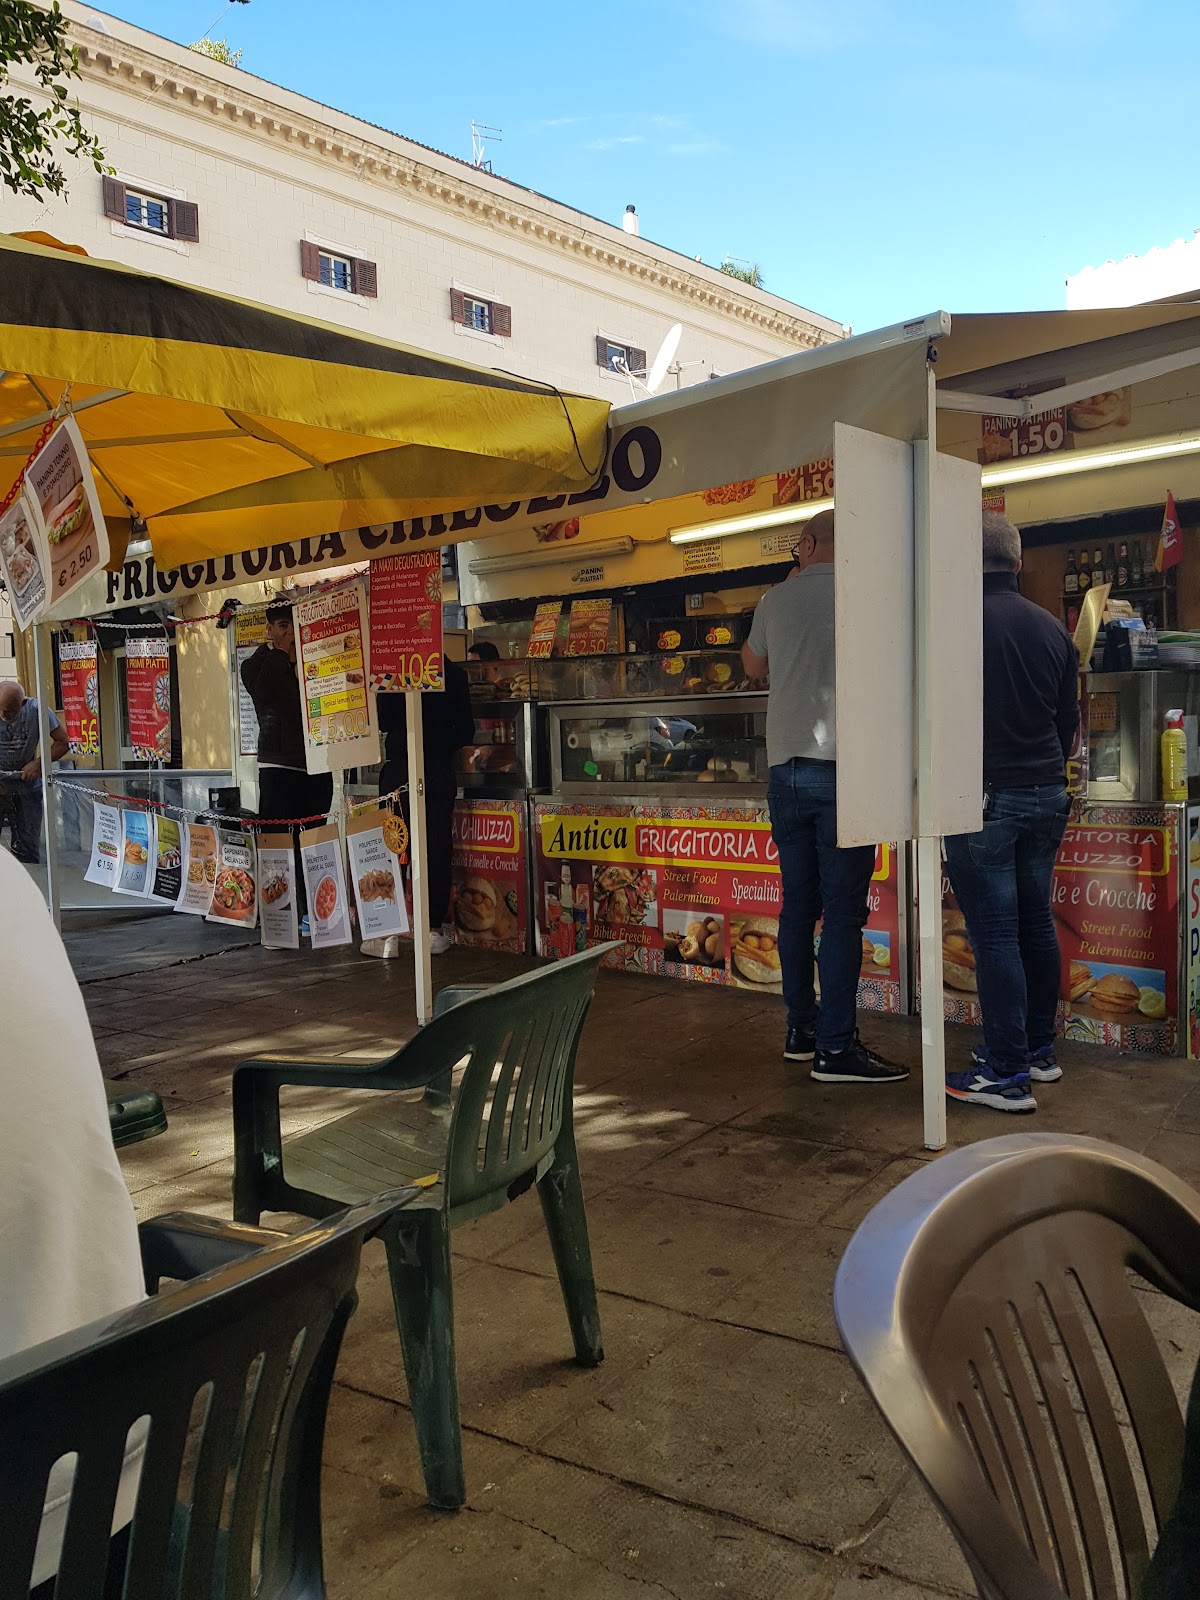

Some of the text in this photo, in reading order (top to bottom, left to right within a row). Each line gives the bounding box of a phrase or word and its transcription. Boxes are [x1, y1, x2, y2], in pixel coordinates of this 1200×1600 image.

[1010, 421, 1064, 457] 1.50
[58, 569, 67, 588] €
[580, 565, 604, 576] PANINI
[322, 615, 345, 628] TYPICAL
[334, 621, 359, 634] TASTING
[145, 658, 168, 669] PIATTI
[460, 815, 512, 844] CHILUZZO
[548, 819, 628, 853] Antica
[639, 828, 758, 858] FRIGGITORIA
[468, 853, 490, 869] Panelle
[494, 856, 519, 872] Crocchè
[663, 868, 718, 886] Street Food
[663, 888, 721, 906] Palermitano
[731, 877, 780, 905] Specialità
[1071, 888, 1079, 904] e
[1085, 879, 1157, 911] Crocchè
[593, 924, 652, 946] Bibite Fresche
[1080, 919, 1153, 940] Street Food
[1079, 940, 1155, 961] Palermitano
